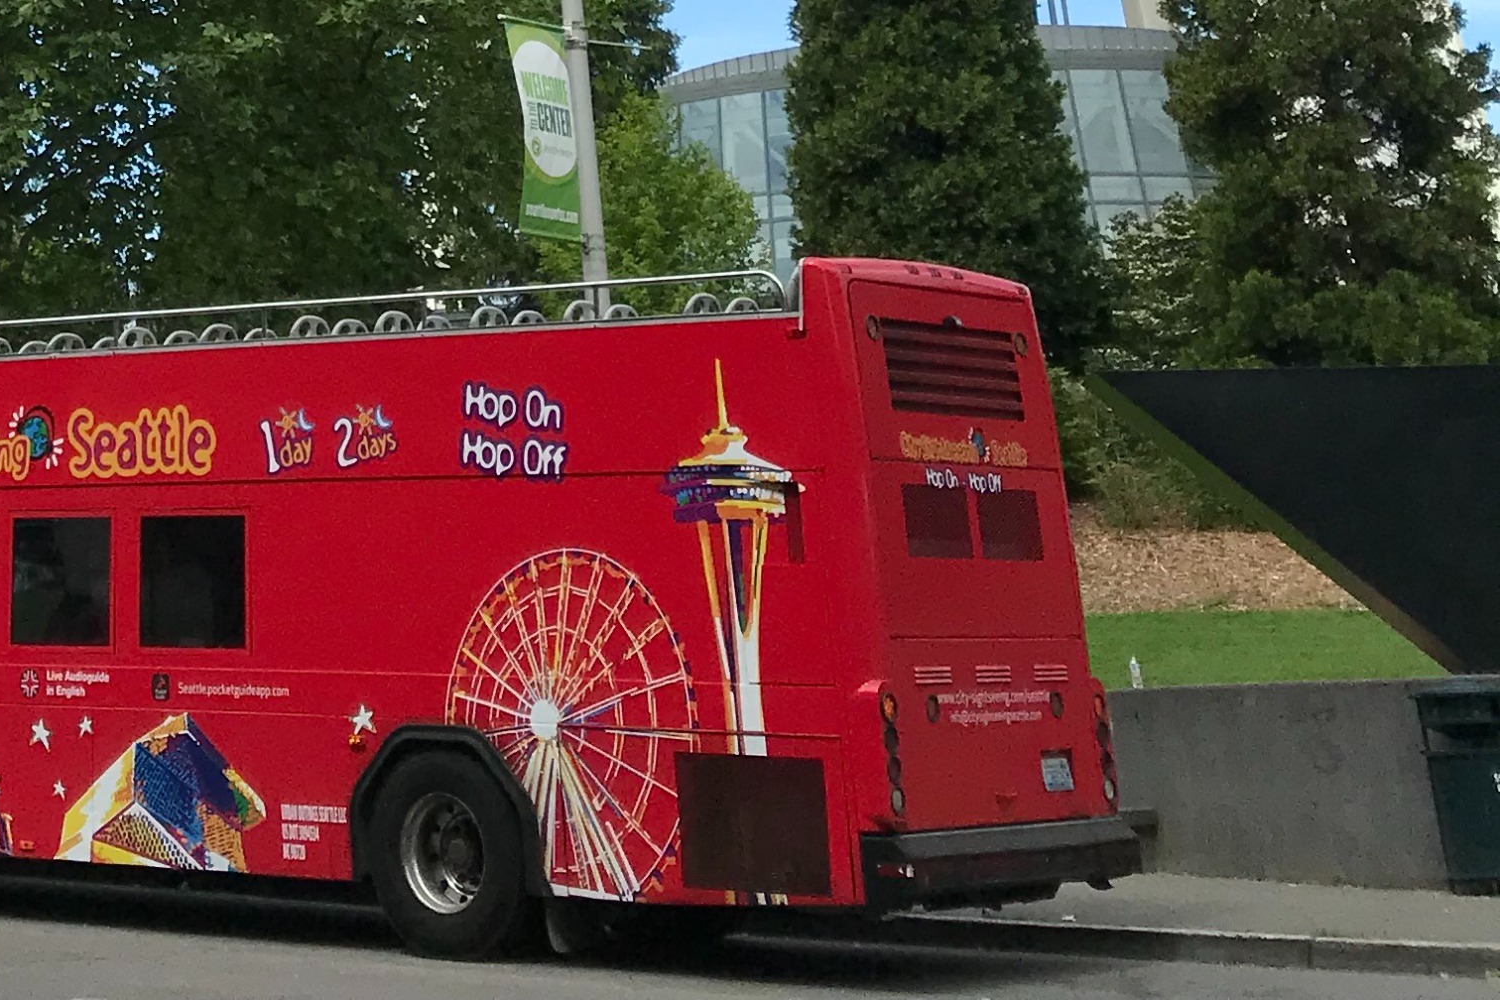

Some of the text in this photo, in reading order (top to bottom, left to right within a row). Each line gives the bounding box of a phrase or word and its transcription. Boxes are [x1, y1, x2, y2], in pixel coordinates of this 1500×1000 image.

[521, 71, 568, 106] WELCOME
[537, 102, 572, 138] CENTER
[465, 384, 561, 429] Hop On
[67, 404, 217, 479] Seattle
[279, 437, 312, 468] day
[334, 418, 397, 467] 2 days
[462, 433, 567, 476] Hop Off
[925, 468, 945, 489] Hop
[945, 469, 958, 489] On
[968, 472, 986, 494] Hop
[987, 473, 1001, 493] Off
[46, 670, 110, 685] Live Audioguide
[46, 685, 86, 699] in English
